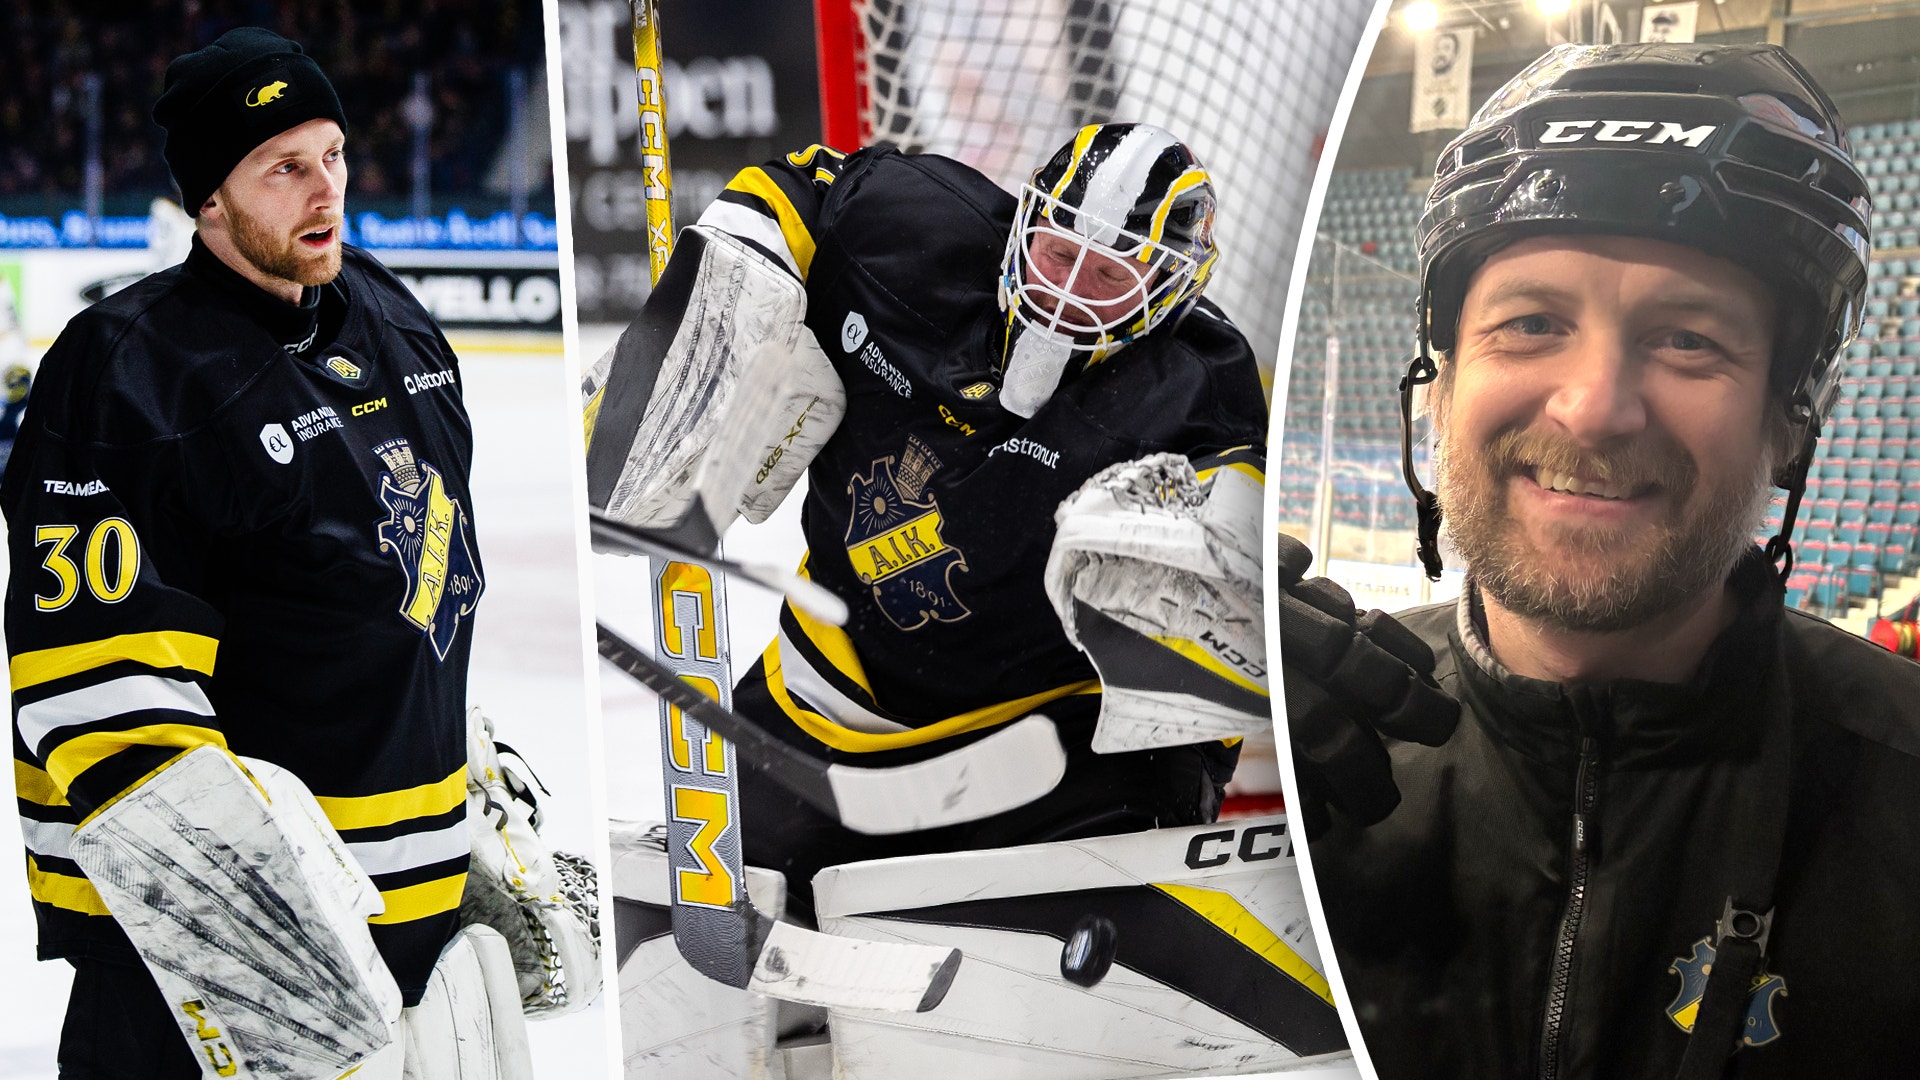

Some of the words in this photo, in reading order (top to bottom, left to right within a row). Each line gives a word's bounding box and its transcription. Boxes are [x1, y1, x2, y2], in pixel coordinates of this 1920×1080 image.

[637, 66, 667, 201] CCM
[1538, 119, 1717, 148] CCM
[860, 349, 912, 399] INSURANCE
[865, 341, 912, 391] ADVANZIA
[296, 416, 344, 442] INSURANCE
[351, 397, 387, 417] CCM
[938, 404, 976, 437] CCM
[43, 479, 110, 496] TEAMEA
[34, 516, 140, 612] 30
[1199, 629, 1267, 678] CCM
[656, 560, 737, 913] CCM
[1184, 823, 1295, 870] CC
